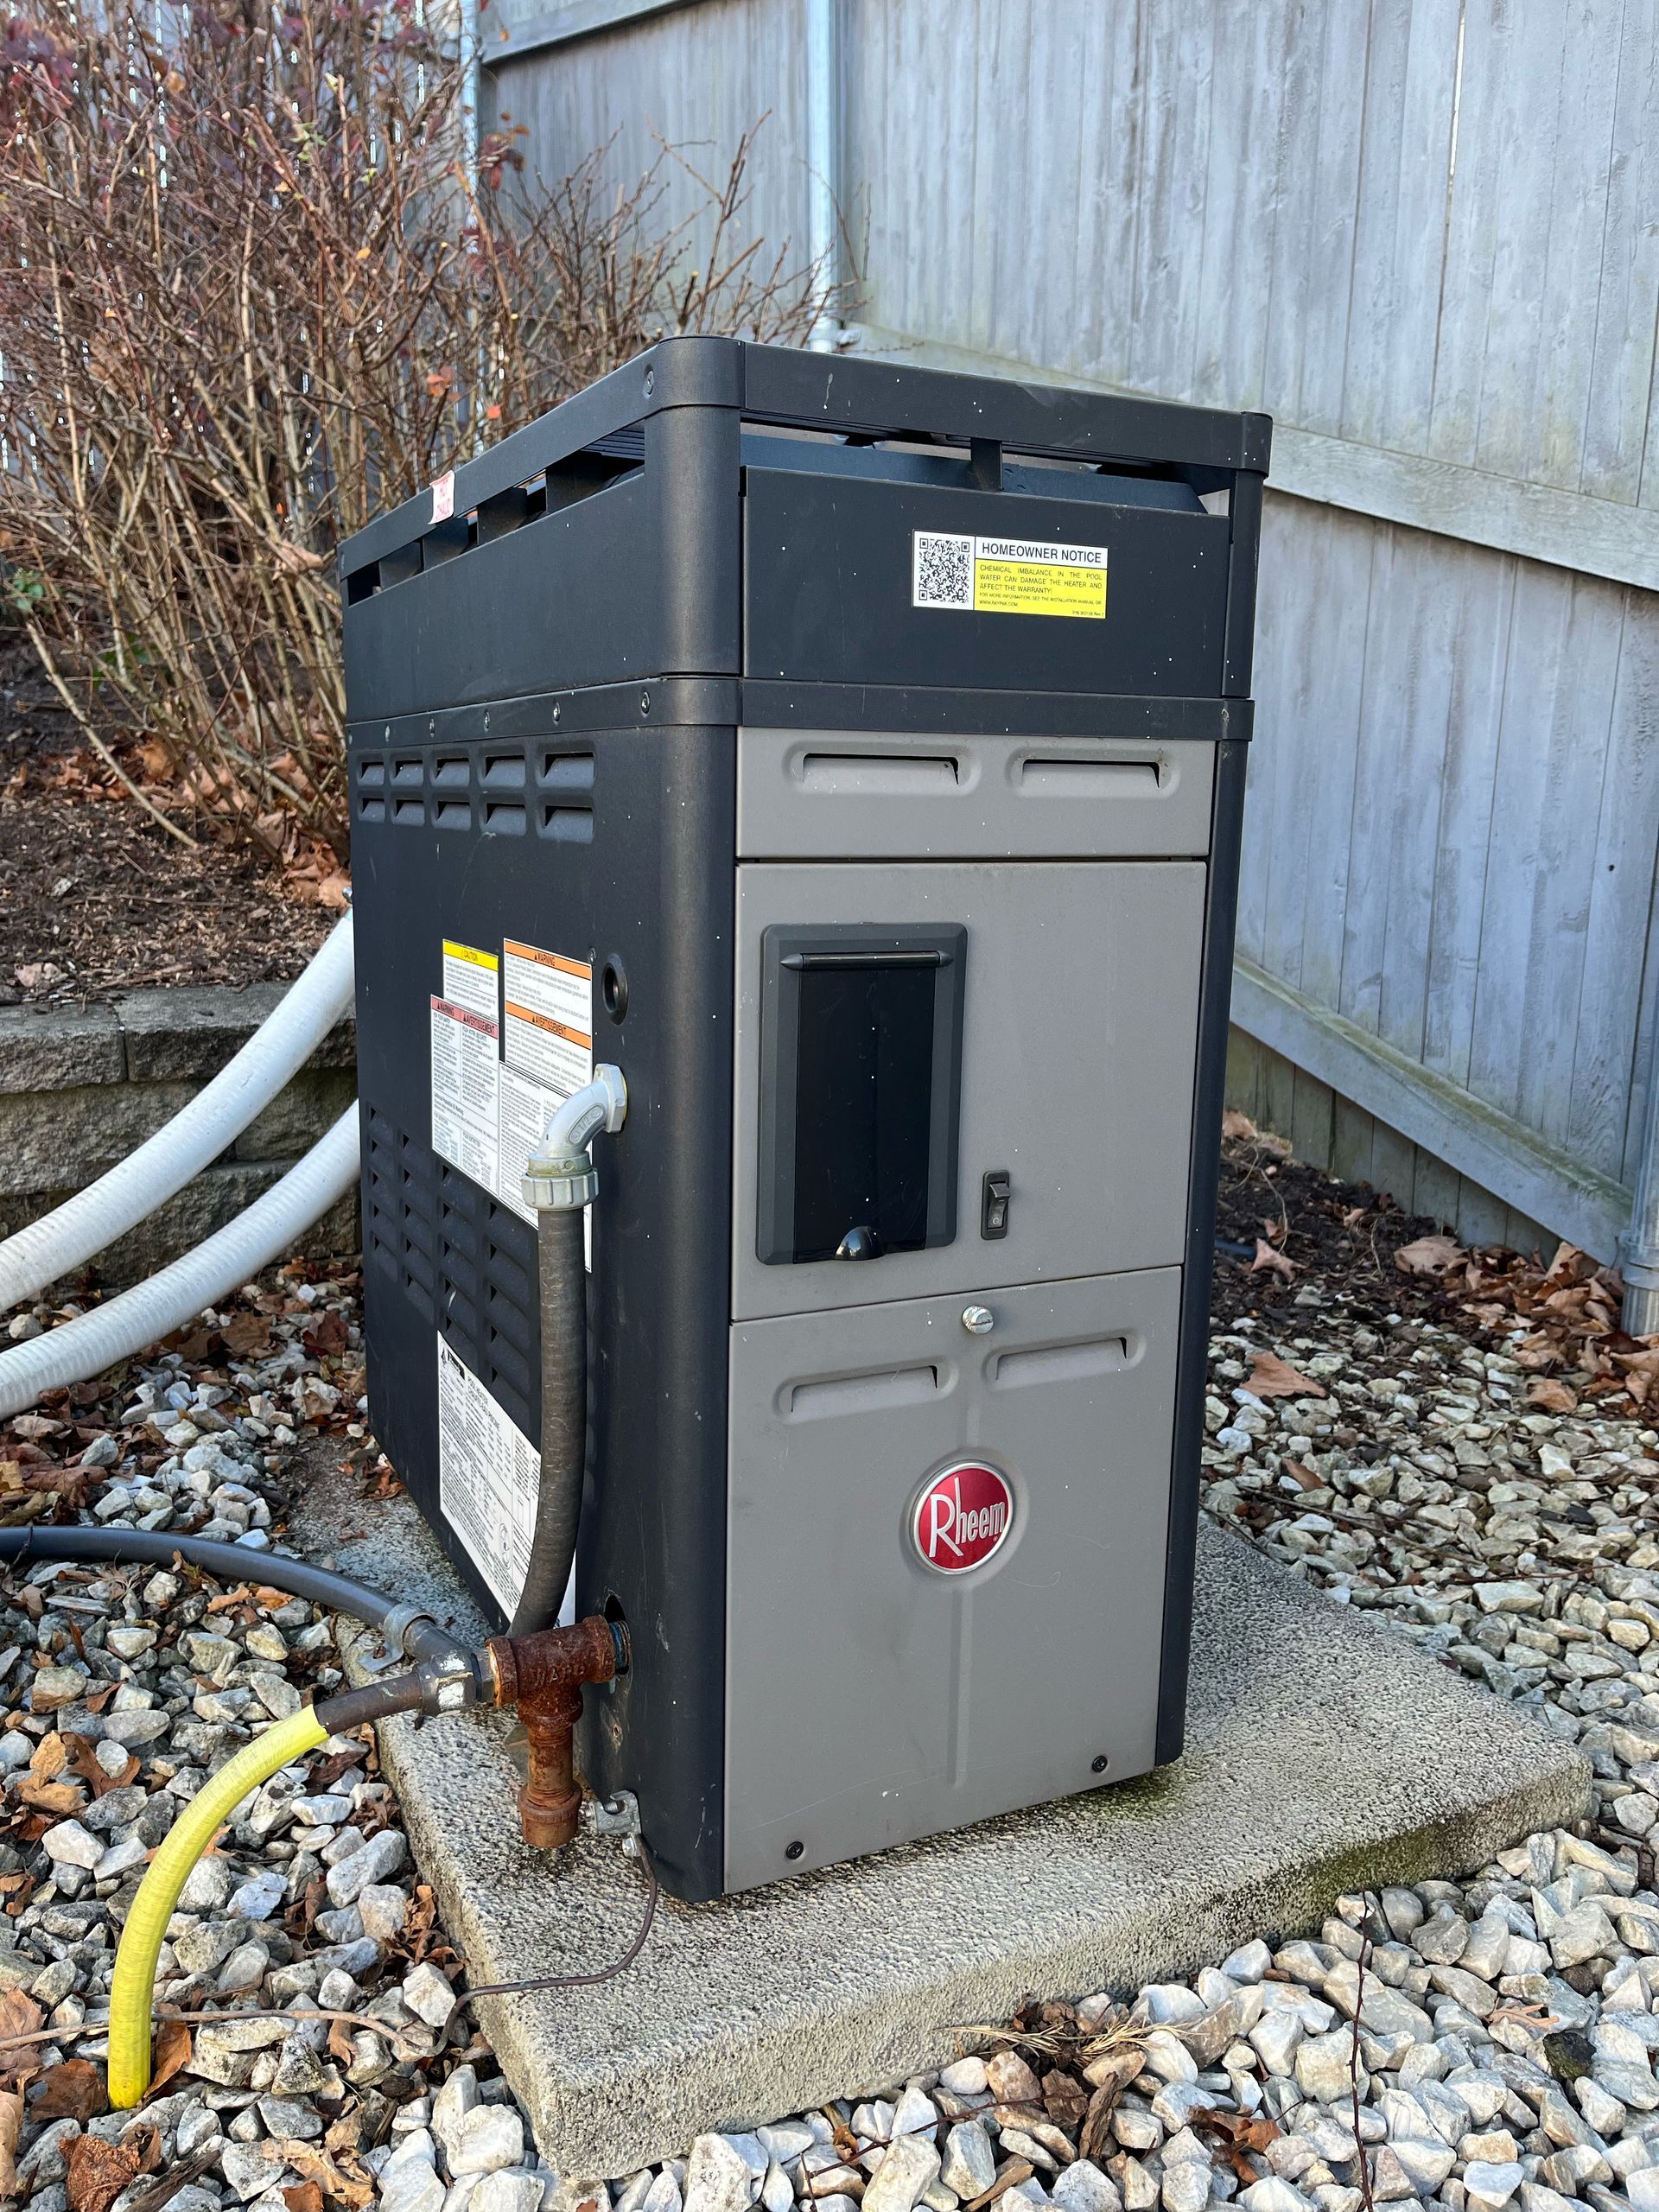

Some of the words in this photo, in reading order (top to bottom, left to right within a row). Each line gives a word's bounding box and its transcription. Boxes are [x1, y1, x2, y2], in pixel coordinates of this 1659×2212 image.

[982, 543, 1058, 559] HOMEOWNER
[1061, 550, 1101, 563] NOTICE
[980, 564, 1012, 573] CHEMICAL
[1017, 568, 1052, 576] IMBALANCE
[464, 949, 479, 962] CAUTION
[537, 953, 556, 967] WARNING
[535, 1015, 567, 1036] AVERTISSEMENT
[929, 1477, 1006, 1558] Rheem
